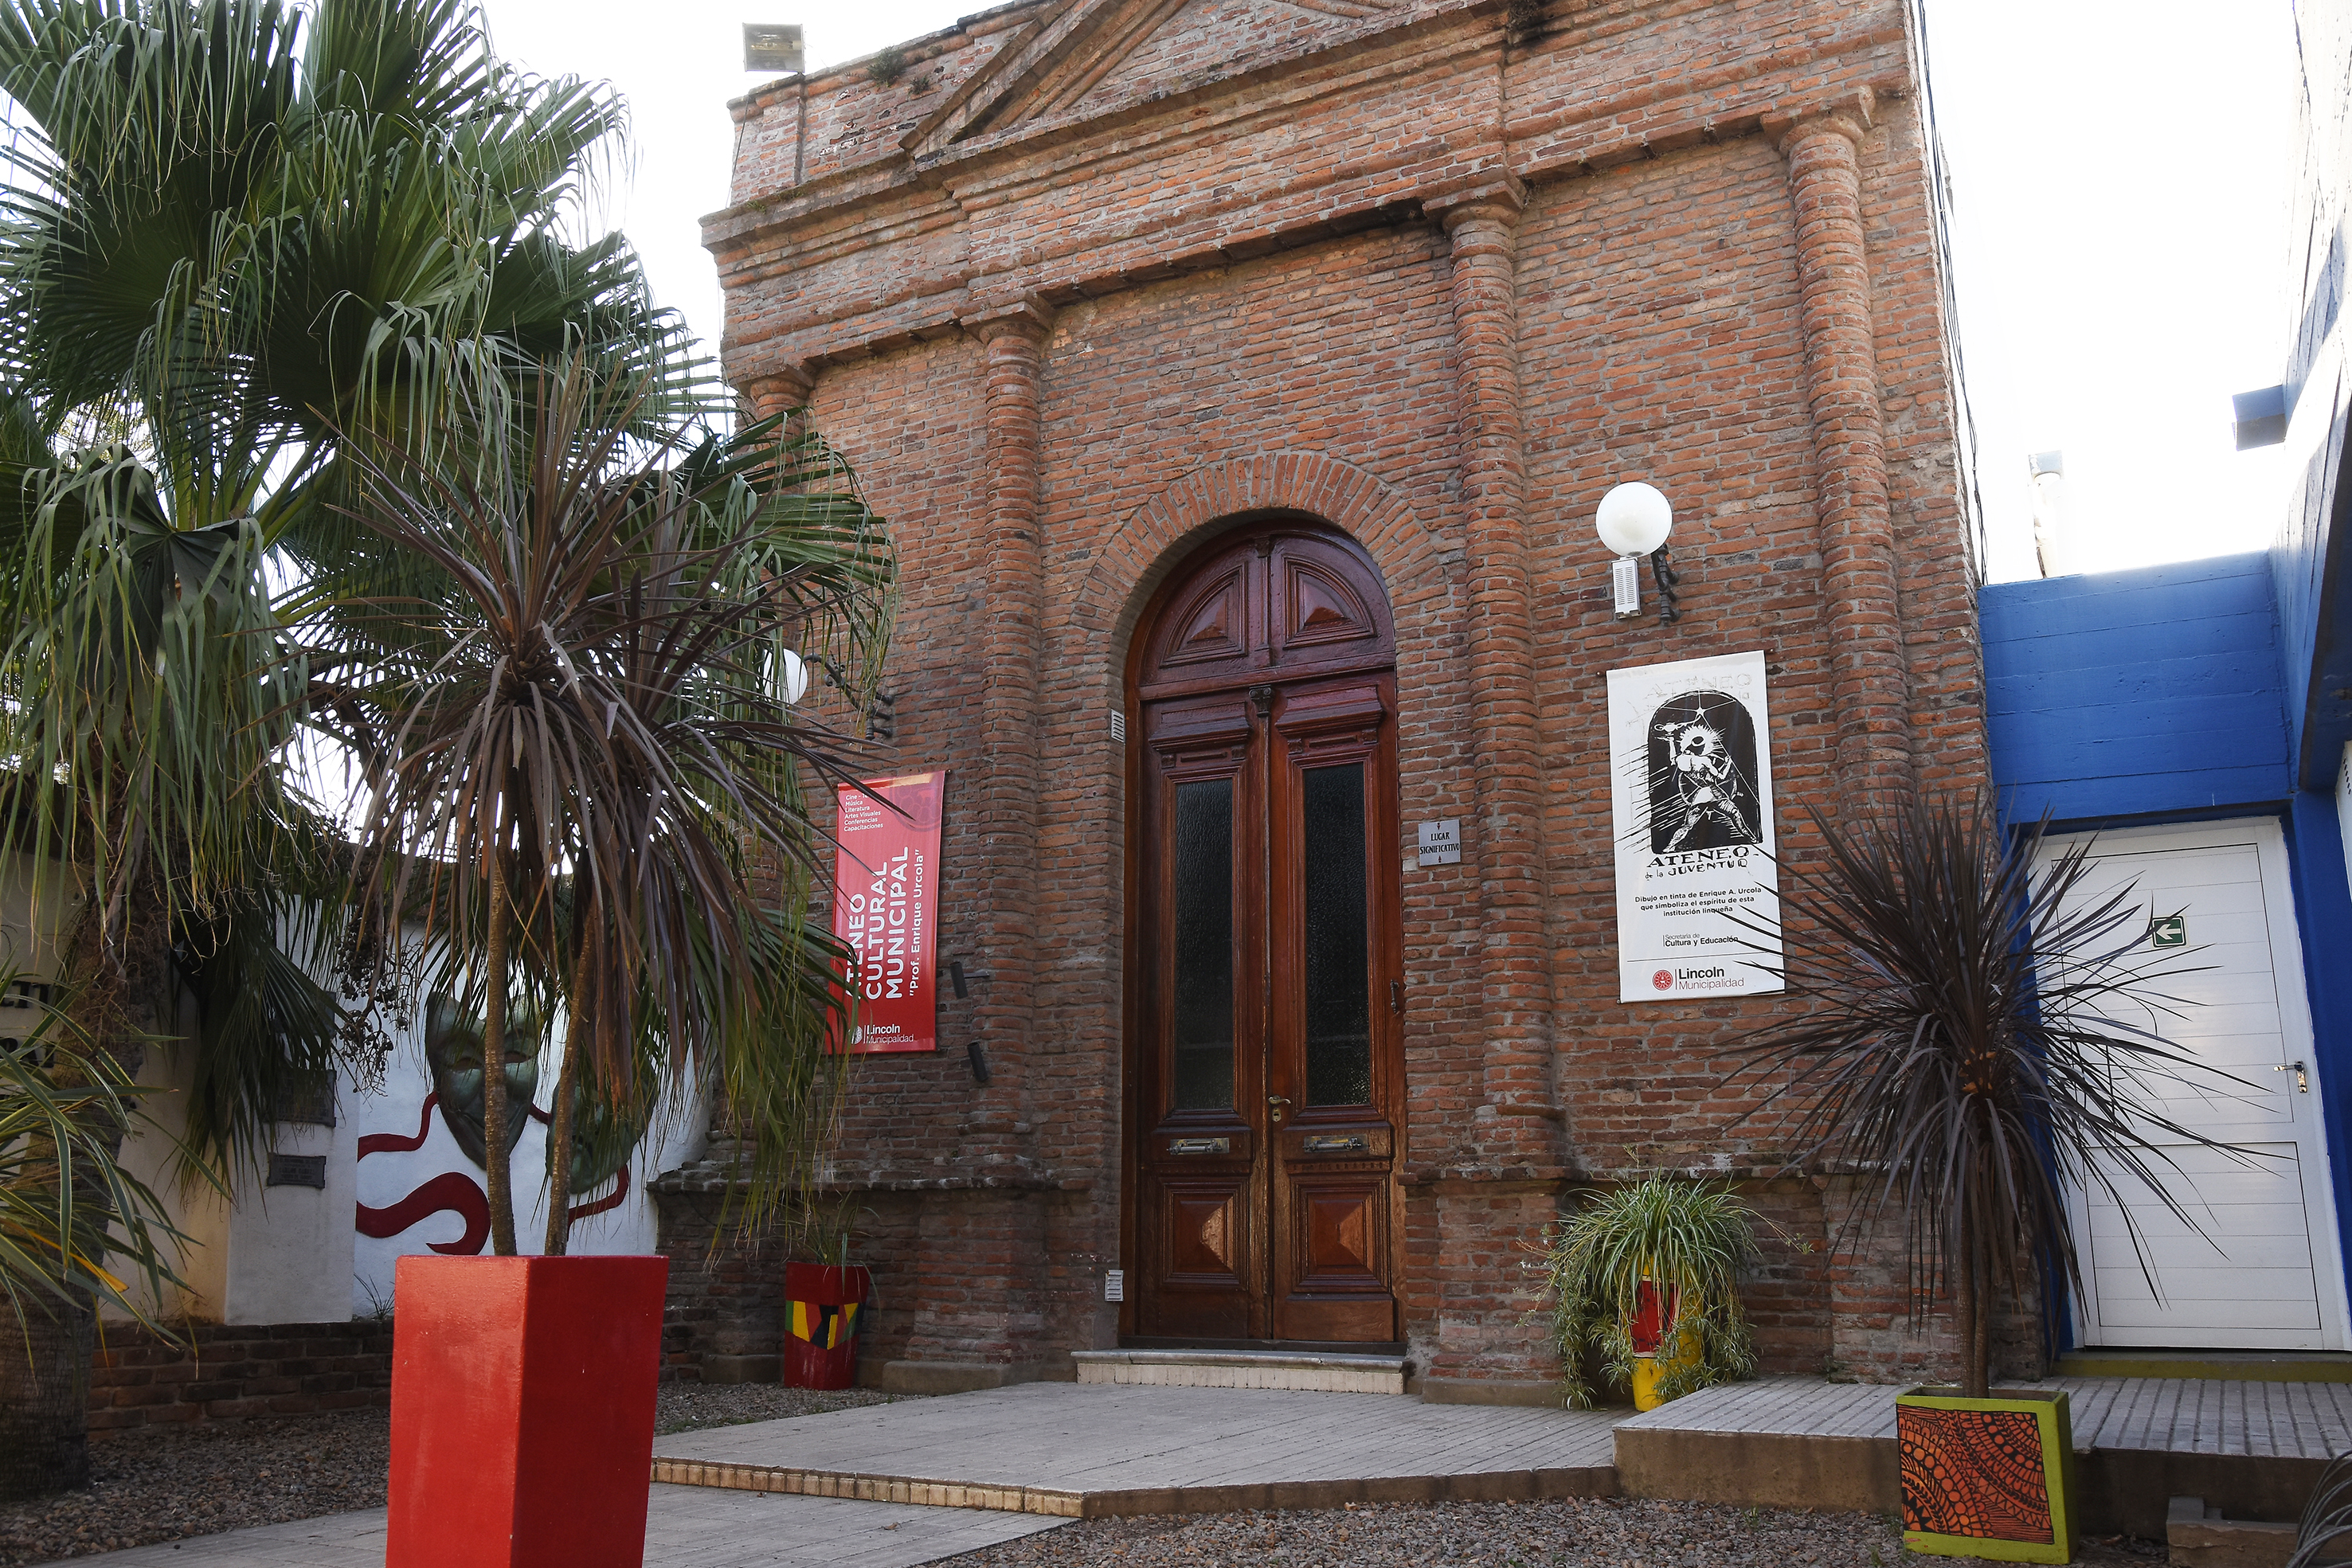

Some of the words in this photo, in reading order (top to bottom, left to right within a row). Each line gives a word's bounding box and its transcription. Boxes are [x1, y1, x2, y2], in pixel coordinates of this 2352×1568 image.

[1430, 832, 1450, 841] LUGAR
[1419, 843, 1460, 854] SIGNIFICATIVO
[1646, 847, 1749, 868] ATENEO
[913, 849, 924, 898] Urcola"
[1699, 897, 1726, 906] espíritu
[1702, 905, 1733, 914] linqueña
[886, 847, 908, 999] MUNICIPAL
[911, 902, 922, 953] Enrique
[866, 862, 887, 999] CULTURAL
[1700, 936, 1739, 944] Educación
[1678, 966, 1724, 980] Lincoln
[1679, 977, 1744, 990] Municipalidad
[867, 1023, 901, 1034] Lincoln
[866, 1034, 914, 1045] Municipalidad
